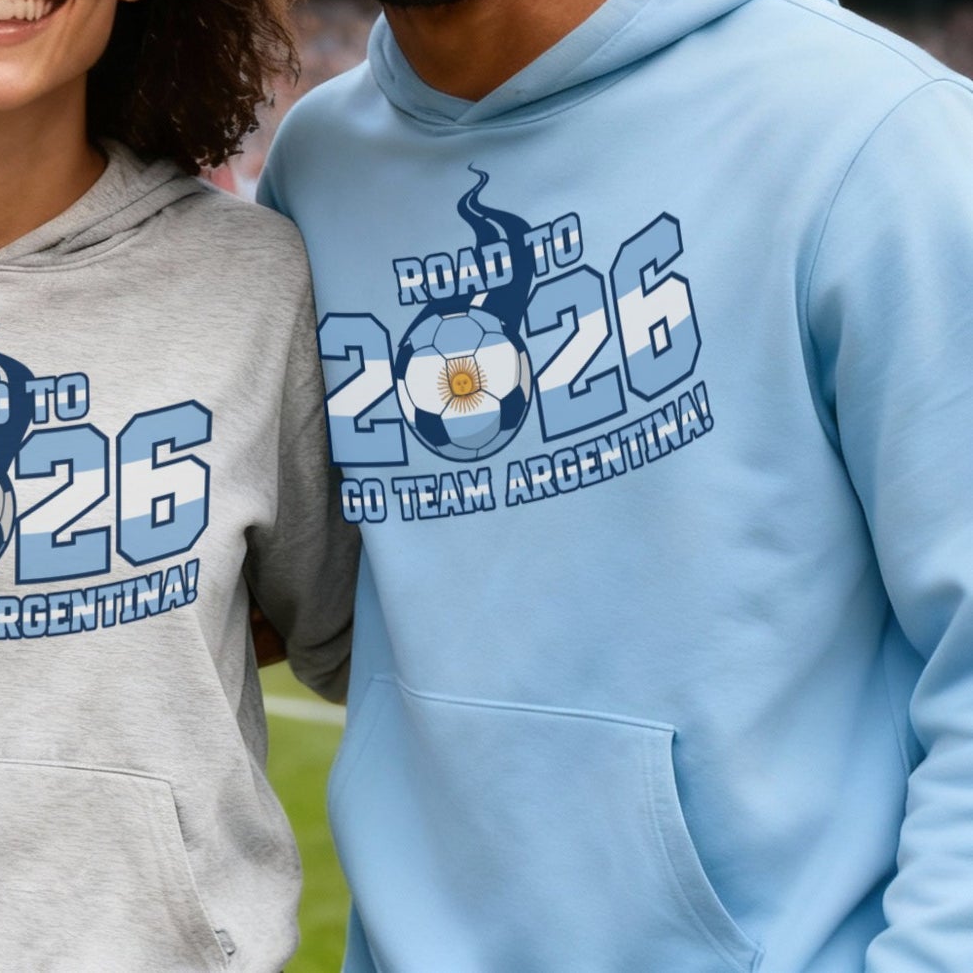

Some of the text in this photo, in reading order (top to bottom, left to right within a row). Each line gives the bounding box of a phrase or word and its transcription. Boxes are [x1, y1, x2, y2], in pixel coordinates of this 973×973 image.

[393, 212, 583, 306] ROAD TO
[26, 372, 90, 423] TO
[340, 381, 714, 523] GO TEAM ARGENTINA!
